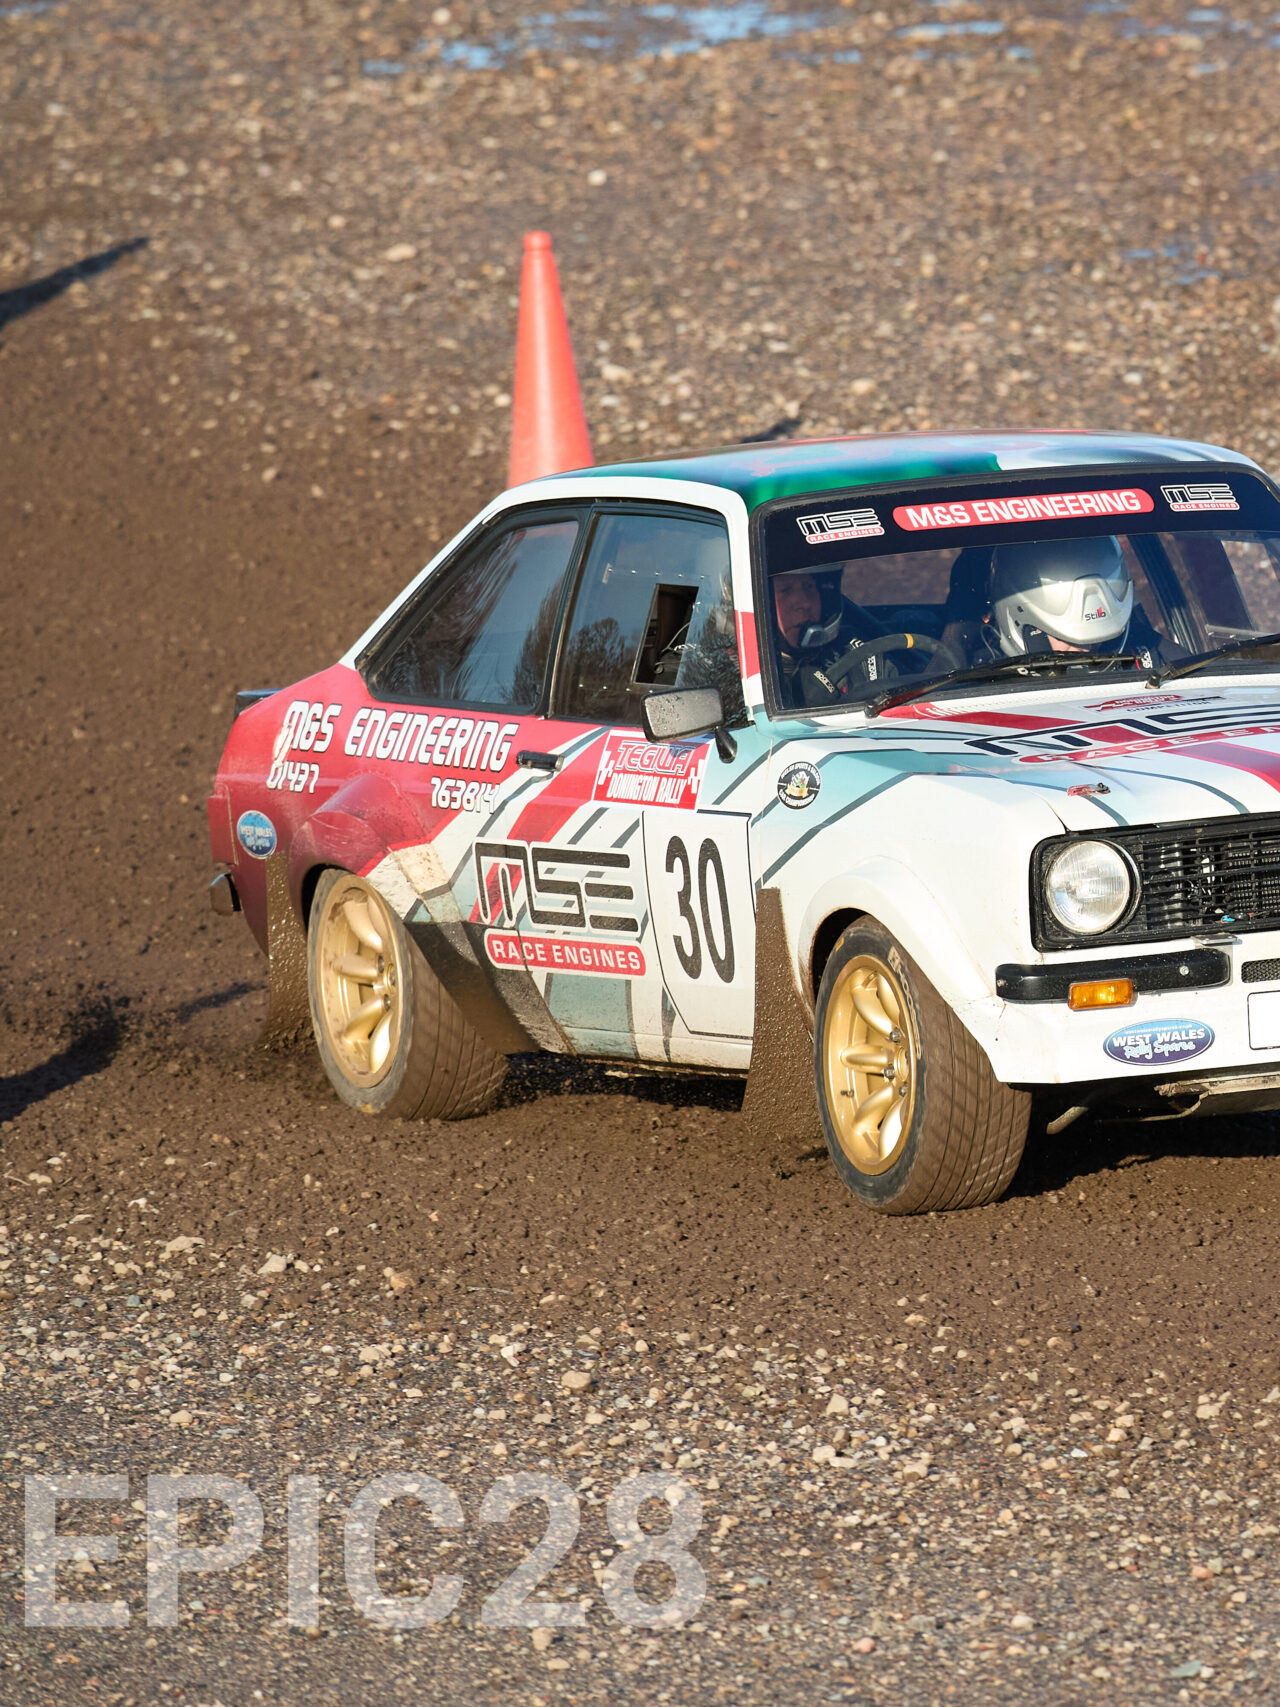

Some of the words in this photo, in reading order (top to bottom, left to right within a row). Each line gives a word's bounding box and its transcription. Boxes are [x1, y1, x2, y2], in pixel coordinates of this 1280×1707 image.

[1160, 483, 1236, 503] MSE
[796, 508, 881, 536] MSE
[906, 505, 971, 529] M&S
[975, 491, 1141, 522] ENGINEERING
[809, 534, 835, 543] RACE
[838, 527, 881, 538] ENGINES
[1084, 607, 1107, 621] Stilo
[344, 707, 519, 772] ENGINEERING
[1041, 735, 1199, 762] RACE
[615, 740, 696, 776] TEGIWA
[267, 760, 320, 794] 01437
[430, 777, 501, 814] 763814
[606, 772, 661, 802] DONINGTON
[656, 776, 688, 804] RALLY
[474, 840, 641, 936] MSE
[665, 835, 735, 984] 30
[491, 940, 547, 963] RACE
[553, 945, 641, 970] ENGINES
[1112, 1032, 1152, 1047] WEST
[1157, 1028, 1206, 1042] WALES
[1123, 1042, 1153, 1060] Rally
[1153, 1039, 1196, 1057] Spares
